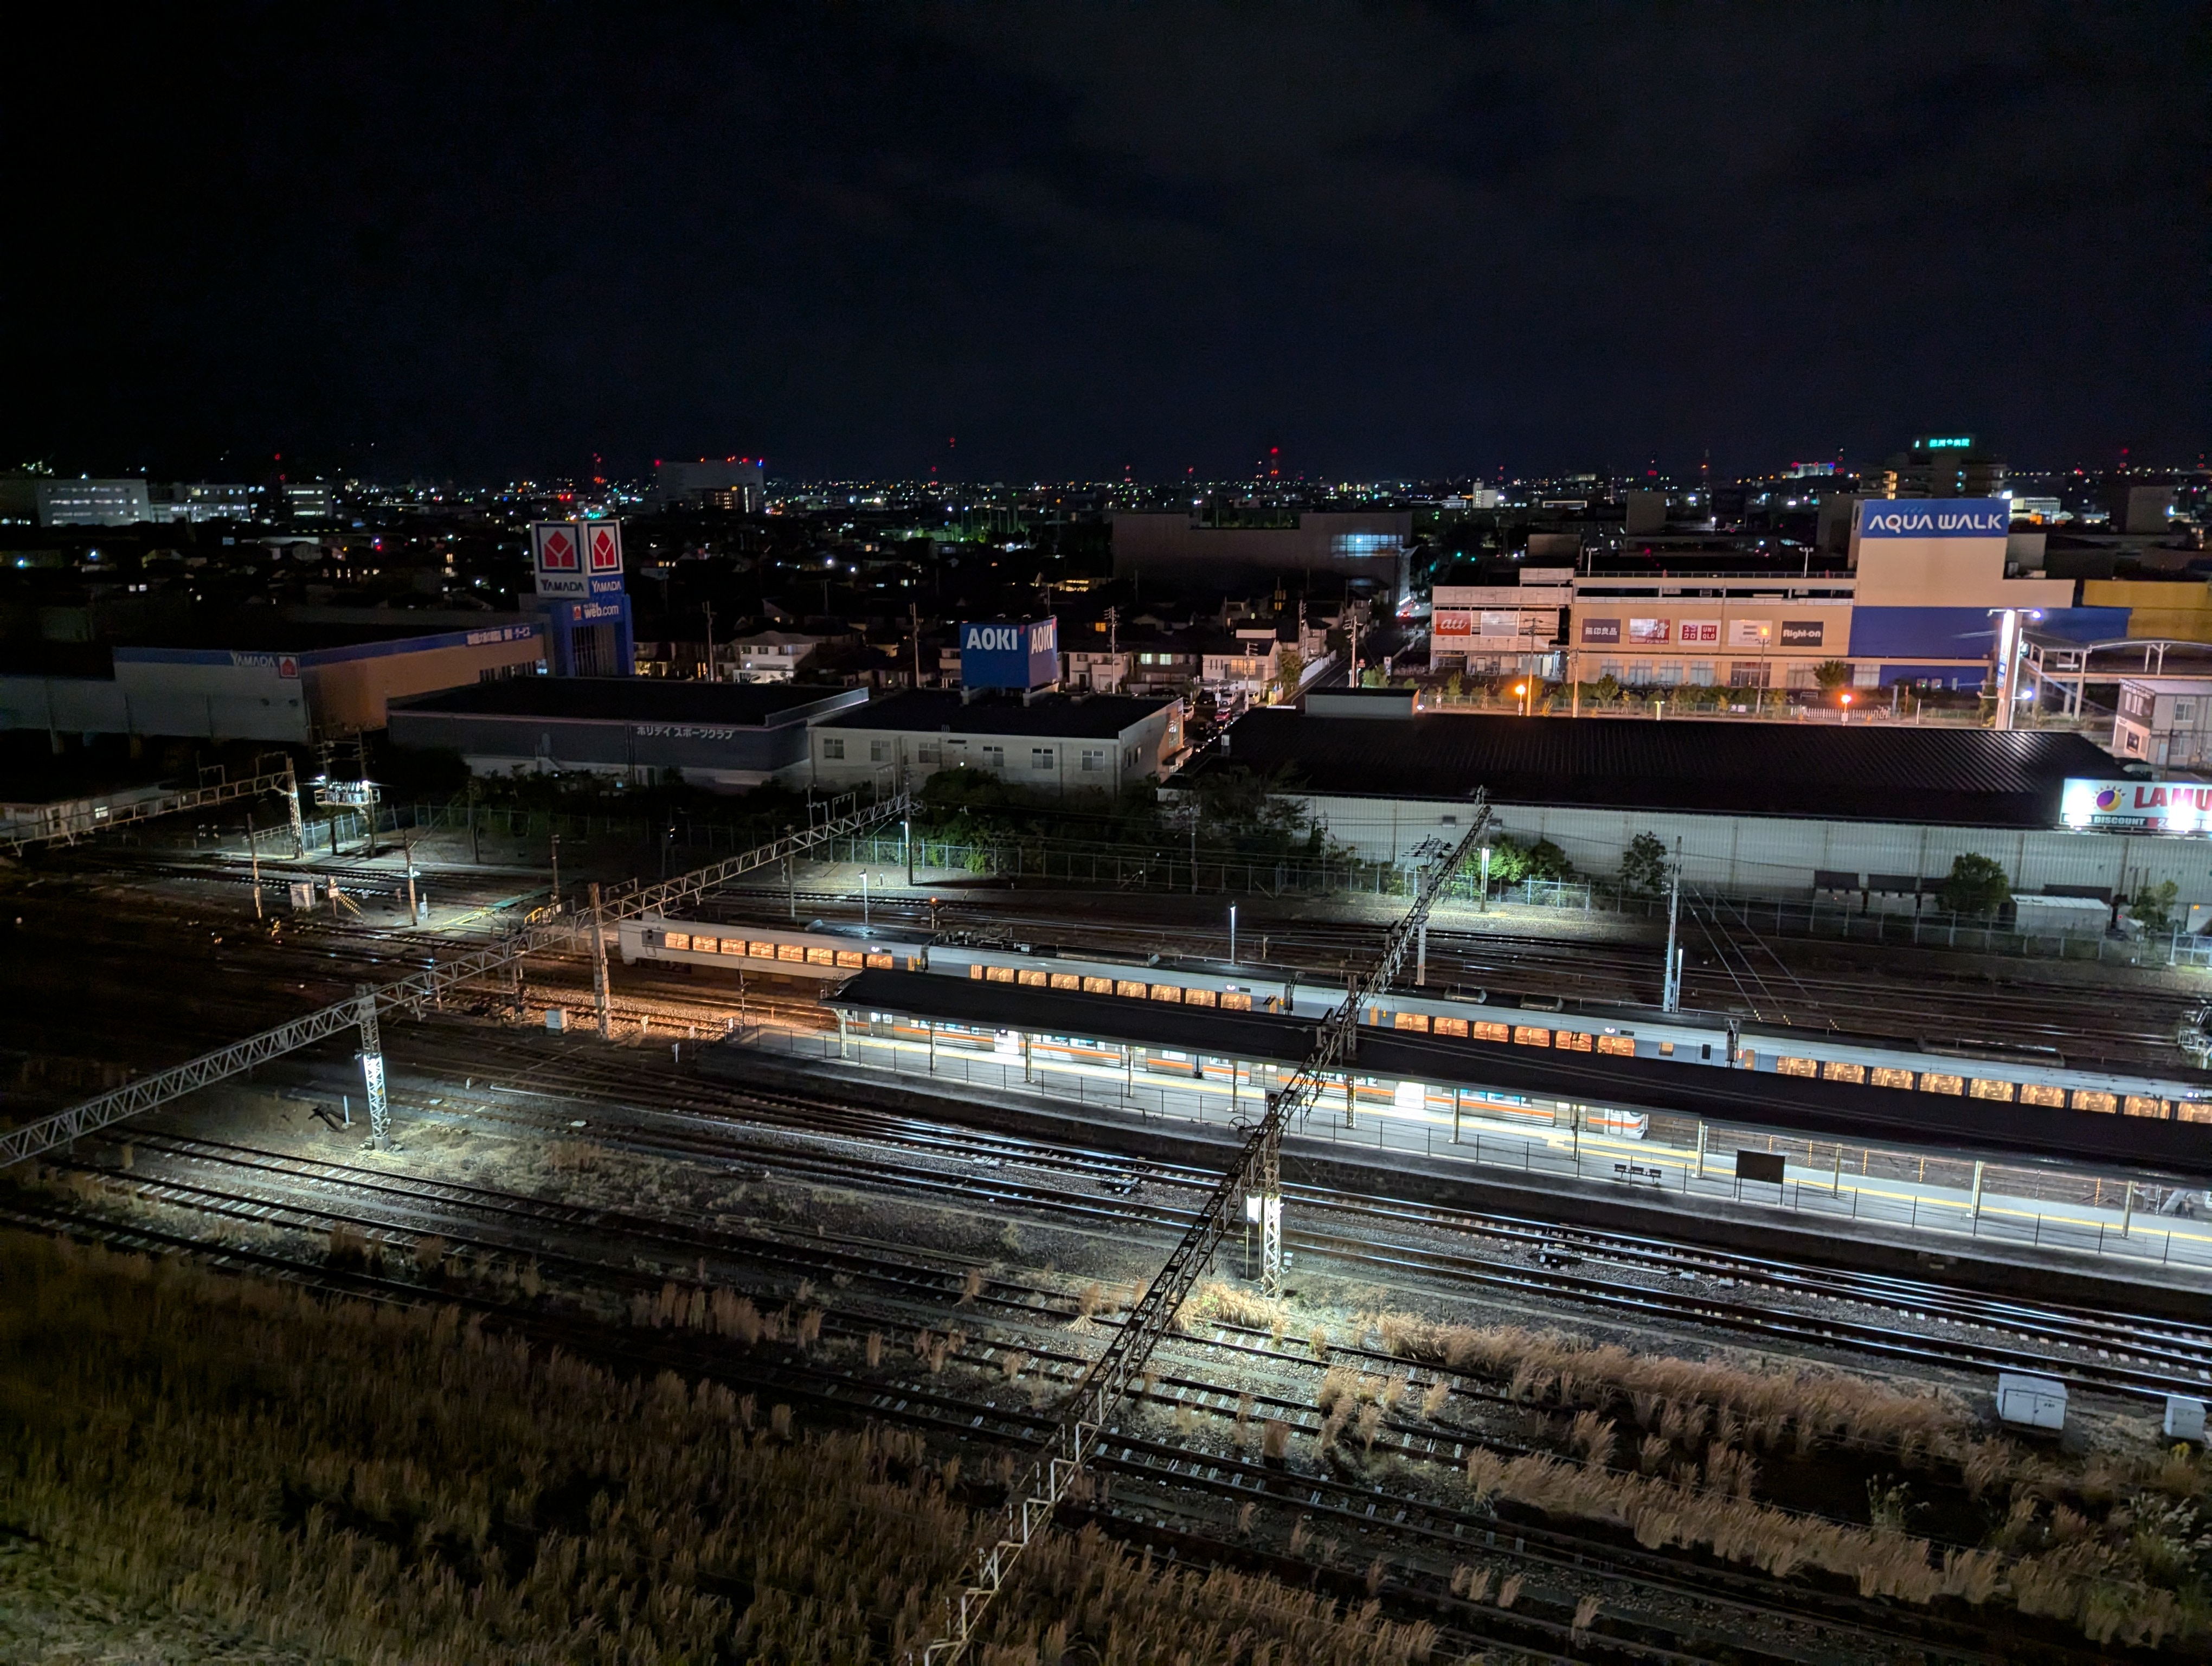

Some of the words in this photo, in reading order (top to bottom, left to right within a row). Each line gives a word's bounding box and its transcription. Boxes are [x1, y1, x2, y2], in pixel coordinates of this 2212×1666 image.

[1869, 514, 1934, 534] AQUA
[1938, 514, 2003, 530] WALK
[540, 579, 584, 592] YAMADA
[591, 580, 622, 593] YAMADA
[584, 602, 619, 618] web.com
[1440, 619, 1468, 630] au
[1585, 627, 1617, 636] 無印良品
[966, 627, 1017, 650] AOKI
[1031, 624, 1053, 655] AOKI
[1783, 629, 1821, 639] Right-on
[229, 650, 275, 667] YAMADA
[2133, 786, 2212, 811] LAMU
[2094, 816, 2146, 826] DISCOUNT
